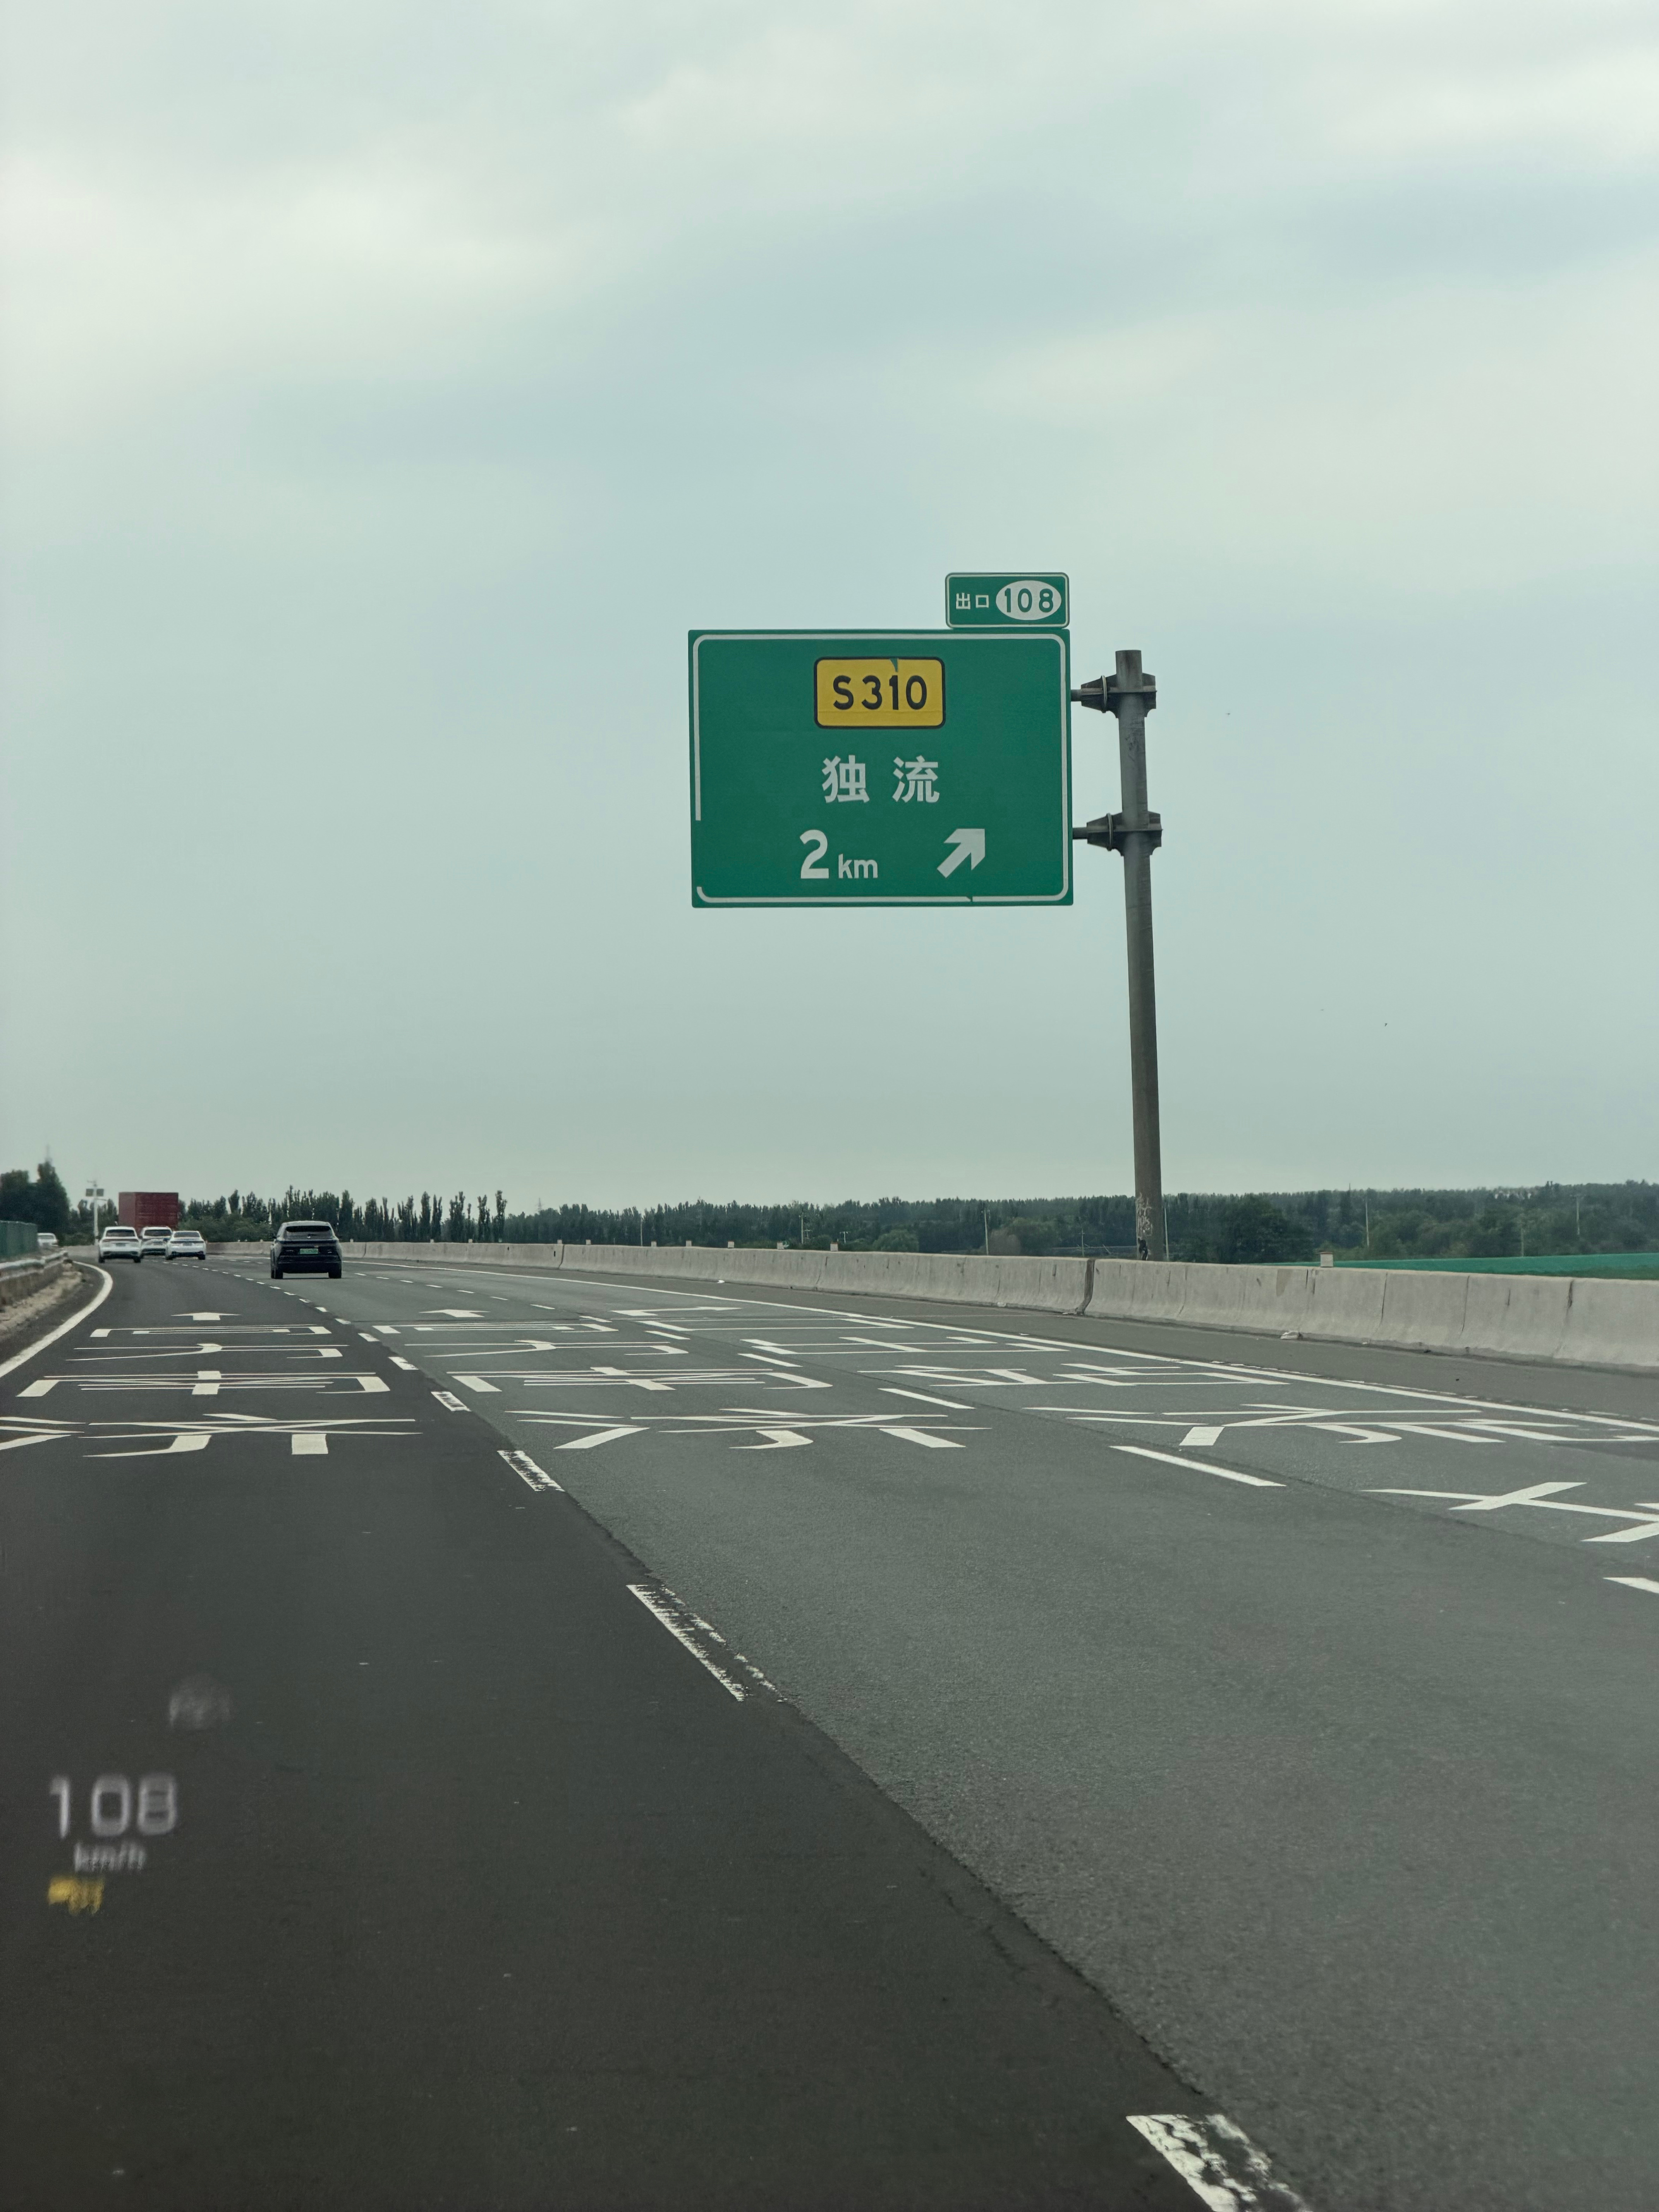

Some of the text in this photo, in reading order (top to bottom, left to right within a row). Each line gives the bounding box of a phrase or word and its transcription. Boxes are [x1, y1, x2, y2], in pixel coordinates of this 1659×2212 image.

[955, 588, 1054, 613] 出口 108
[833, 675, 927, 710] S310
[821, 754, 940, 803] 独流
[800, 830, 878, 879] 2 km
[49, 1774, 178, 1839] 108
